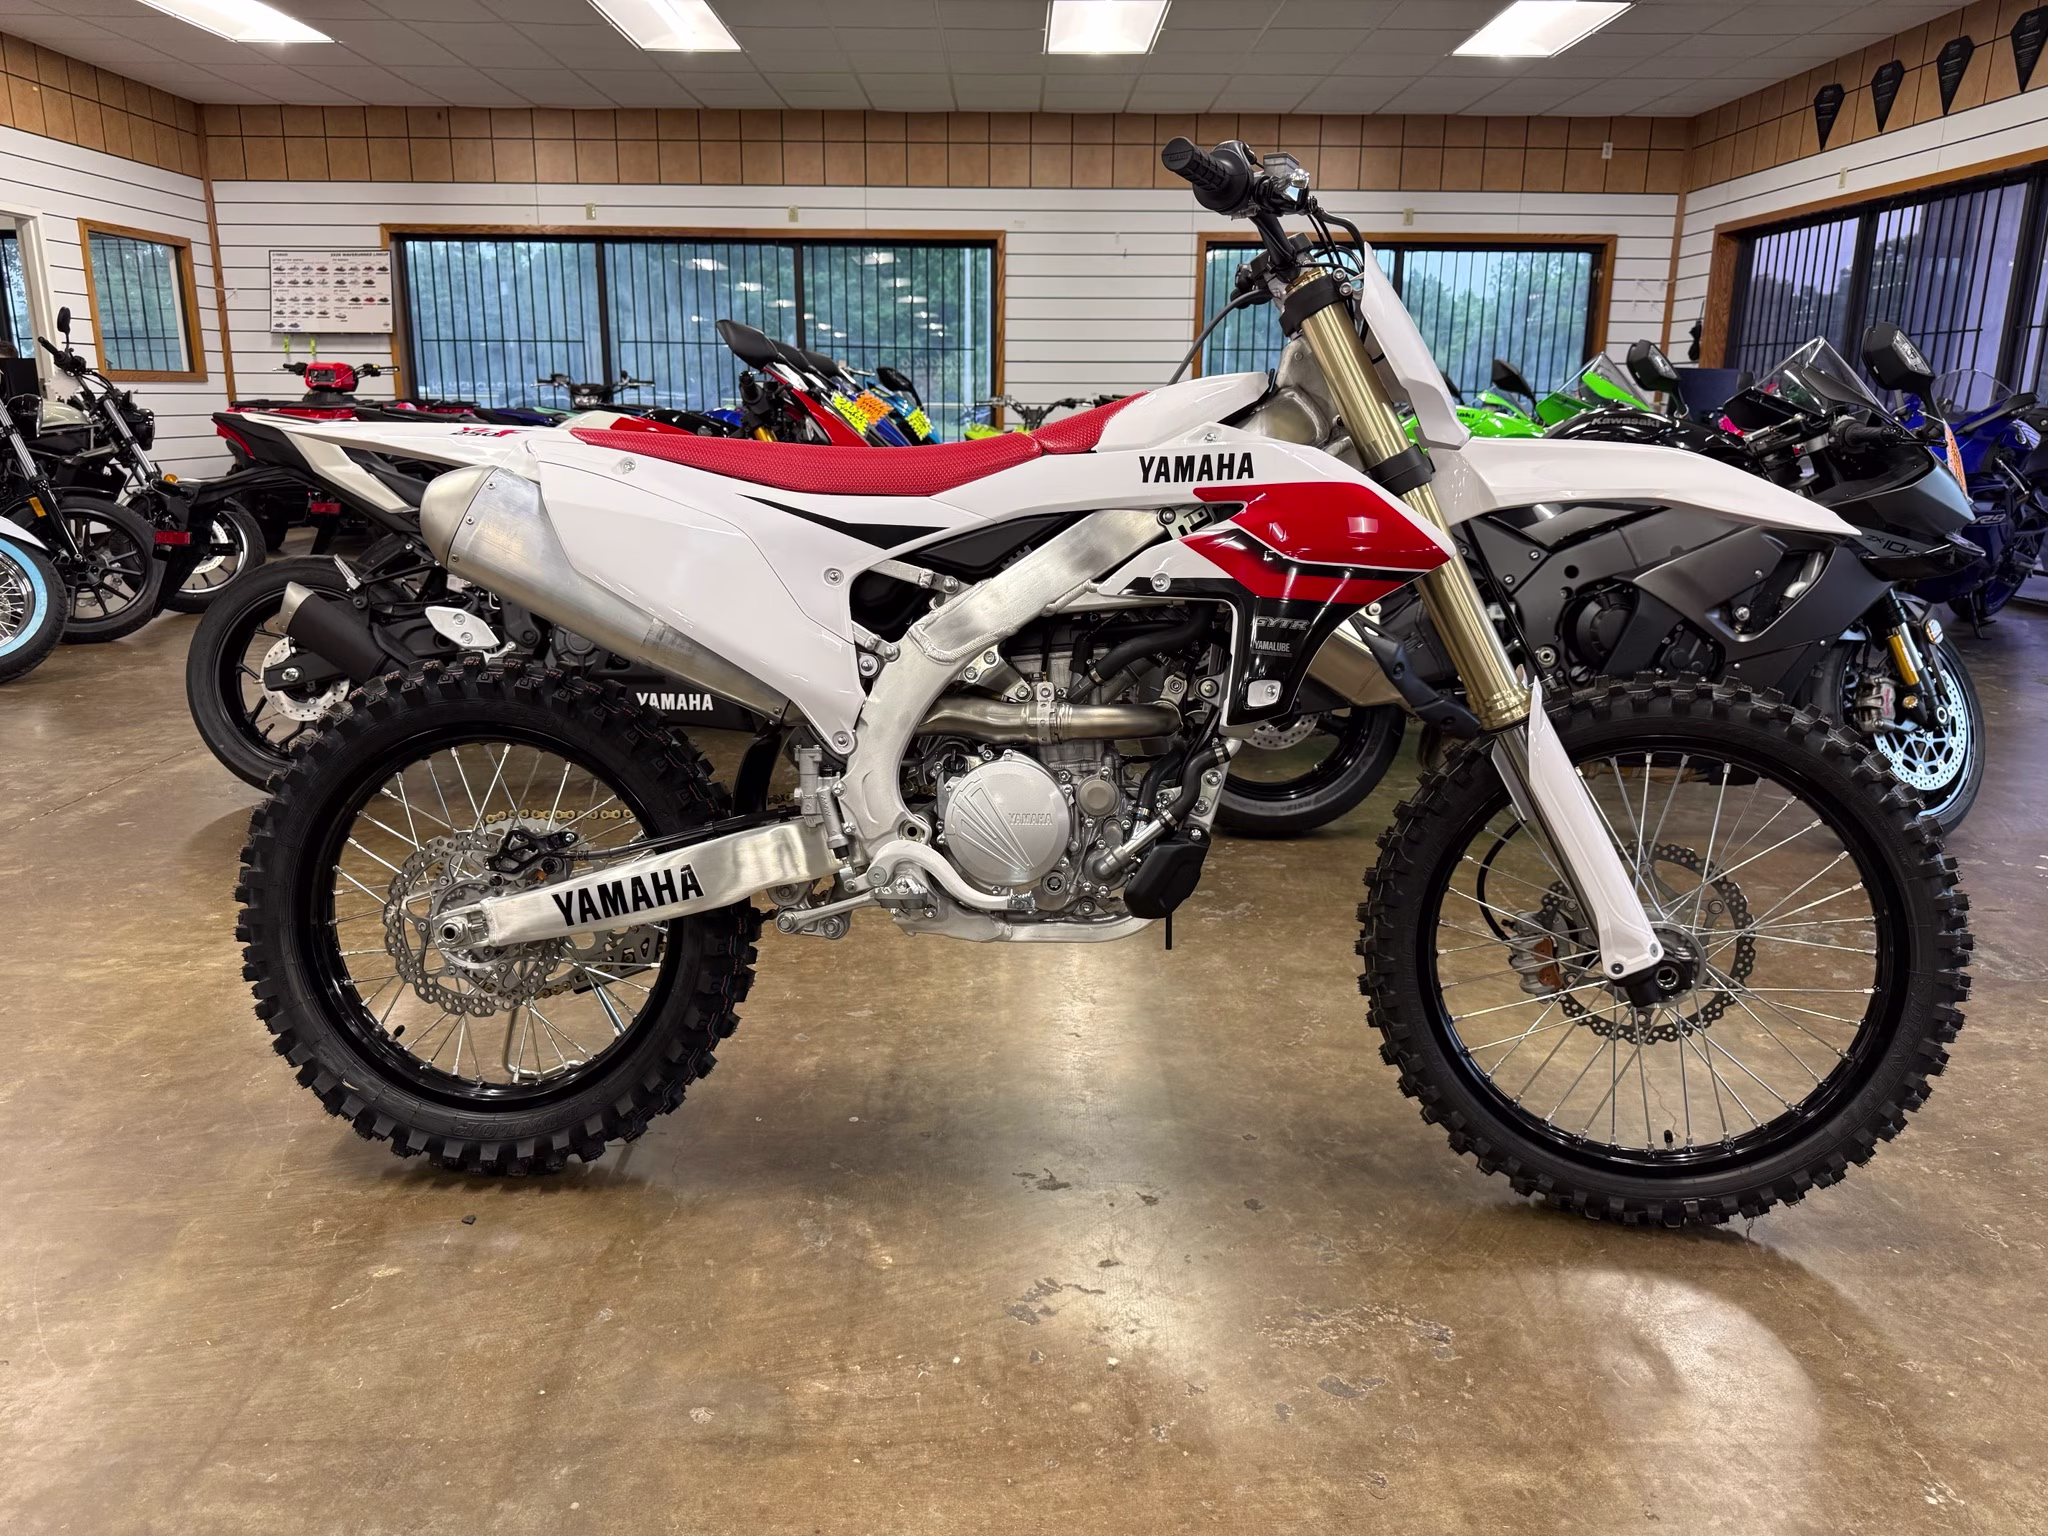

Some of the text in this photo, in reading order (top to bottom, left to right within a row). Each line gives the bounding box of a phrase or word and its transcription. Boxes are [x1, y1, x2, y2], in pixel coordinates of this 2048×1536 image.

[1591, 417, 1660, 428] Kawasaki
[1139, 452, 1254, 483] YAMAHA
[1250, 615, 1310, 631] GYTR
[1254, 640, 1291, 653] YAMALUBE
[635, 692, 714, 711] YAMAHA
[1008, 812, 1053, 826] YAMAHA
[551, 863, 705, 927] YAMAHA
